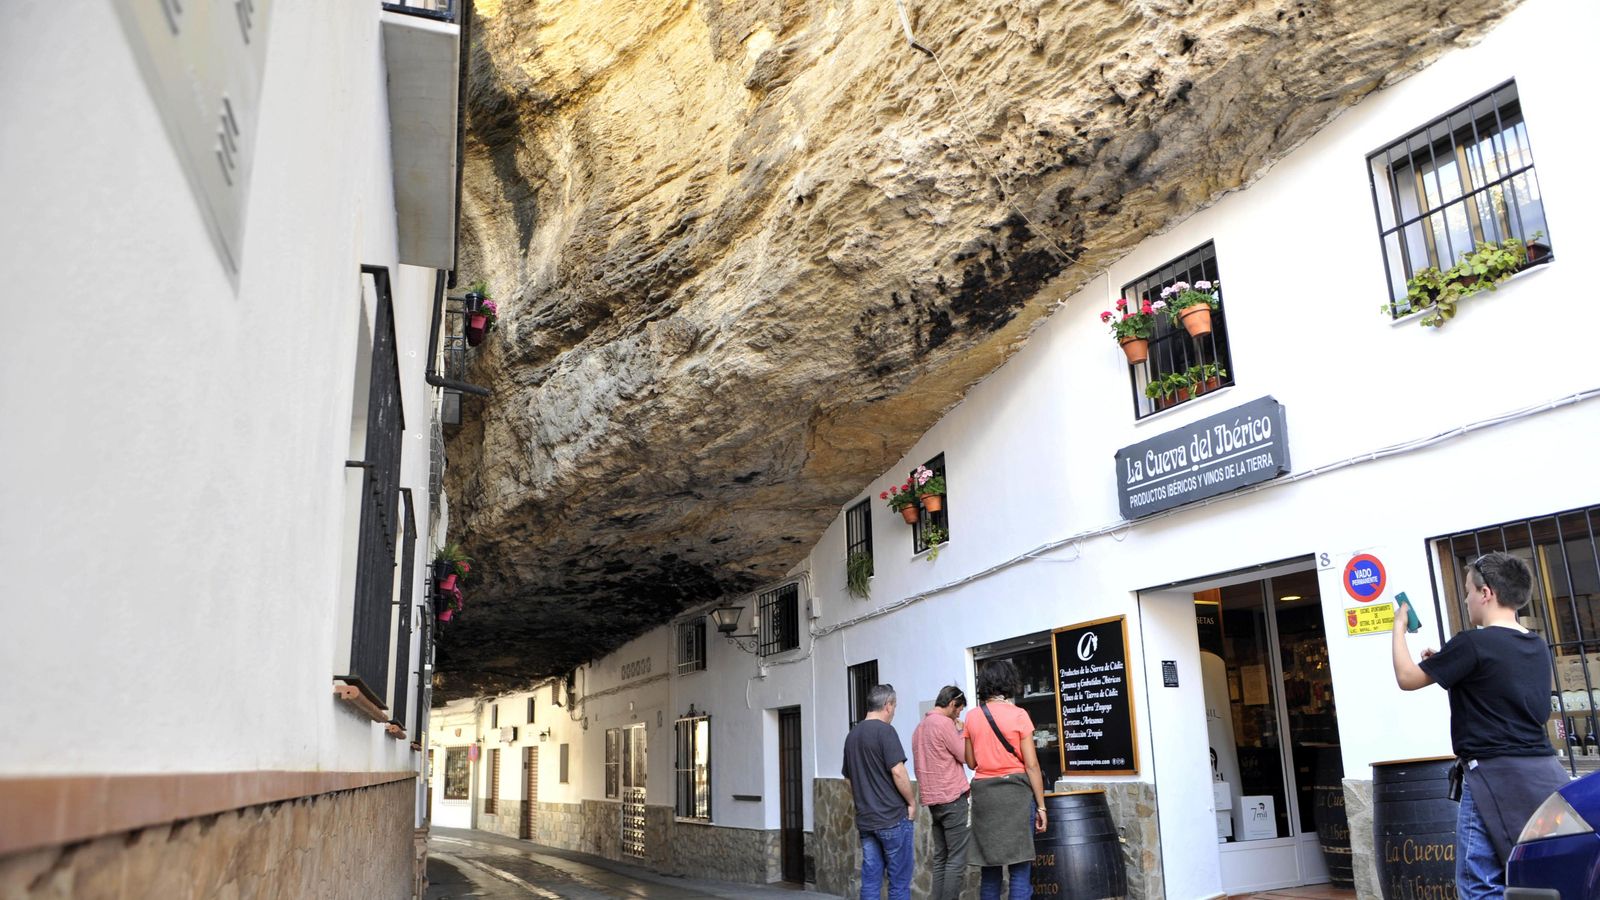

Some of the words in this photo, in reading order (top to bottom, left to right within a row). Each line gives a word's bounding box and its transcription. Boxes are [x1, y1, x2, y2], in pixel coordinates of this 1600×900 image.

[1126, 457, 1143, 484] La
[1145, 444, 1187, 478] Cueva
[1190, 429, 1213, 463] del
[1214, 415, 1272, 455] Ibérico
[1129, 485, 1167, 509] PRODUCTOS
[1166, 475, 1197, 498] IBÉRICOS
[1198, 474, 1203, 488] Y
[1203, 467, 1225, 487] VINOS
[1225, 465, 1235, 479] DE
[1235, 461, 1246, 477] LA
[1246, 452, 1274, 473] TIERRA
[1320, 552, 1331, 567] 8
[1354, 567, 1372, 579] VADO
[1060, 668, 1080, 677] Productos
[1080, 665, 1085, 674] de
[1090, 664, 1104, 673] Sierra
[1104, 662, 1109, 670] de
[1060, 681, 1076, 692] Jamones
[1080, 677, 1101, 687] Embutidos
[1074, 692, 1078, 700] de
[1084, 690, 1099, 699] Tierra
[1100, 689, 1104, 697] de
[1062, 705, 1076, 716] Quesos
[1076, 704, 1081, 713] de
[1081, 703, 1094, 712] Cabra
[1086, 729, 1103, 739] Propia
[1403, 838, 1456, 864] Cueva
